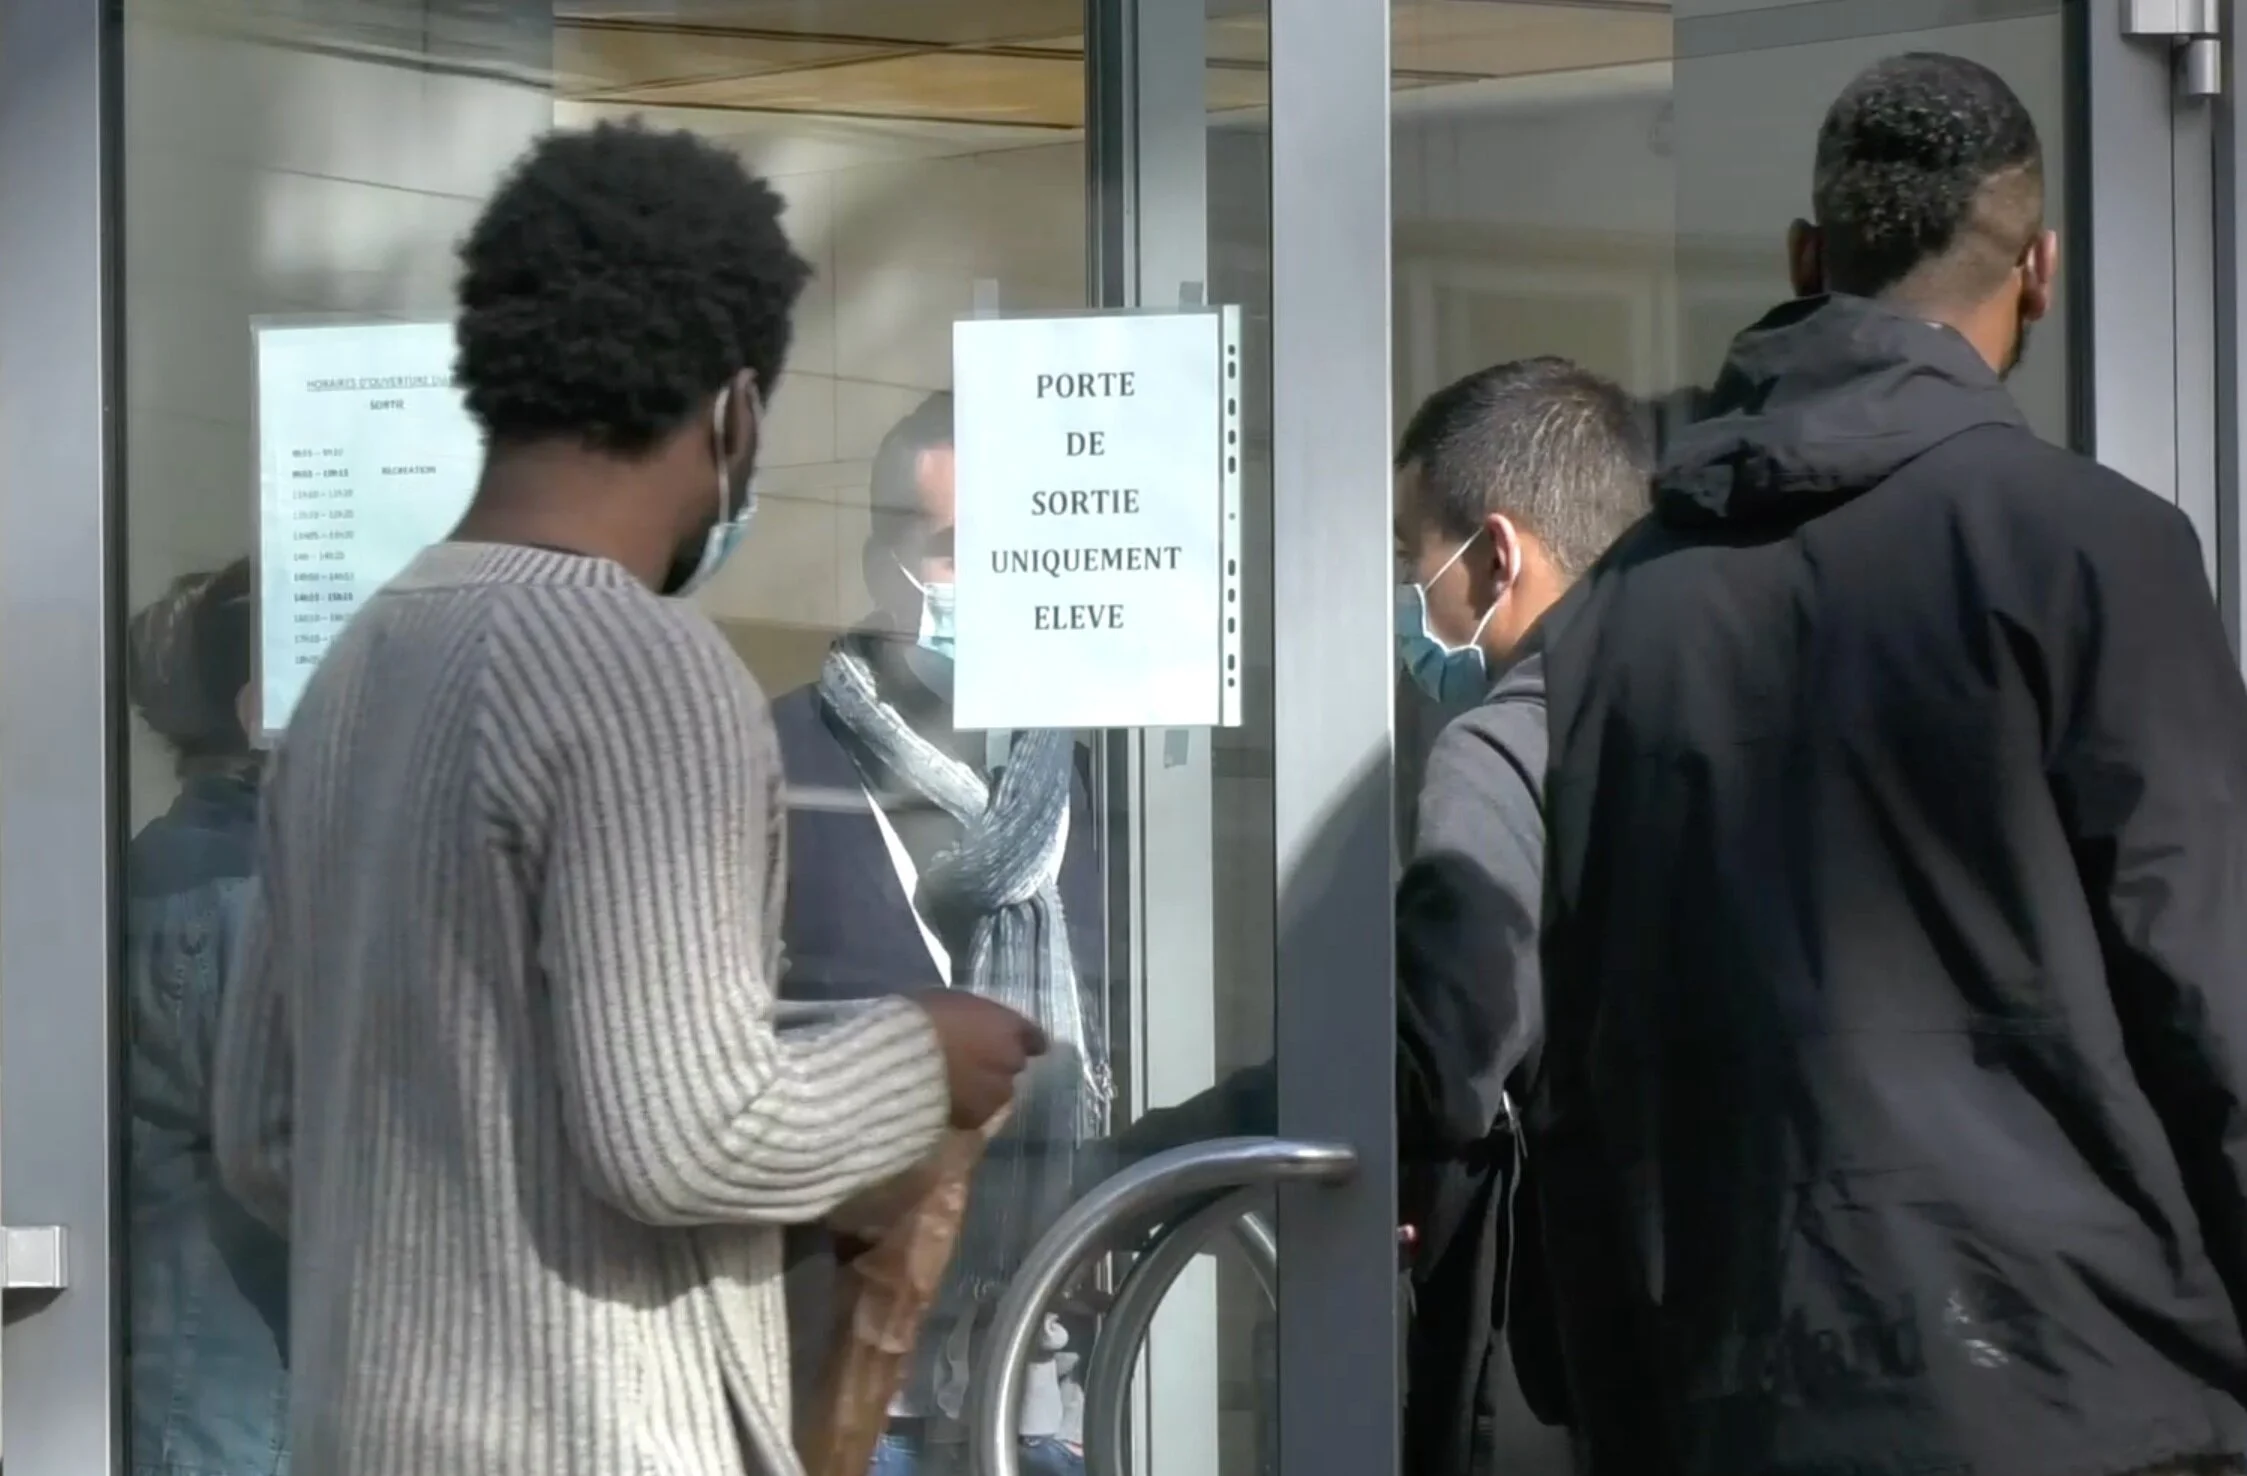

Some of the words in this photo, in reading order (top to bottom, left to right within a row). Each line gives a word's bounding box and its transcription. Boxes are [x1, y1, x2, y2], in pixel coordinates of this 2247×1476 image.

[1036, 371, 1136, 399] PORTE
[1065, 431, 1106, 458] DE
[381, 465, 437, 475] RECREATION
[1031, 488, 1141, 516] SORTIE
[990, 545, 1184, 578] UNIQUEMENT
[1033, 604, 1126, 631] ELEVE
